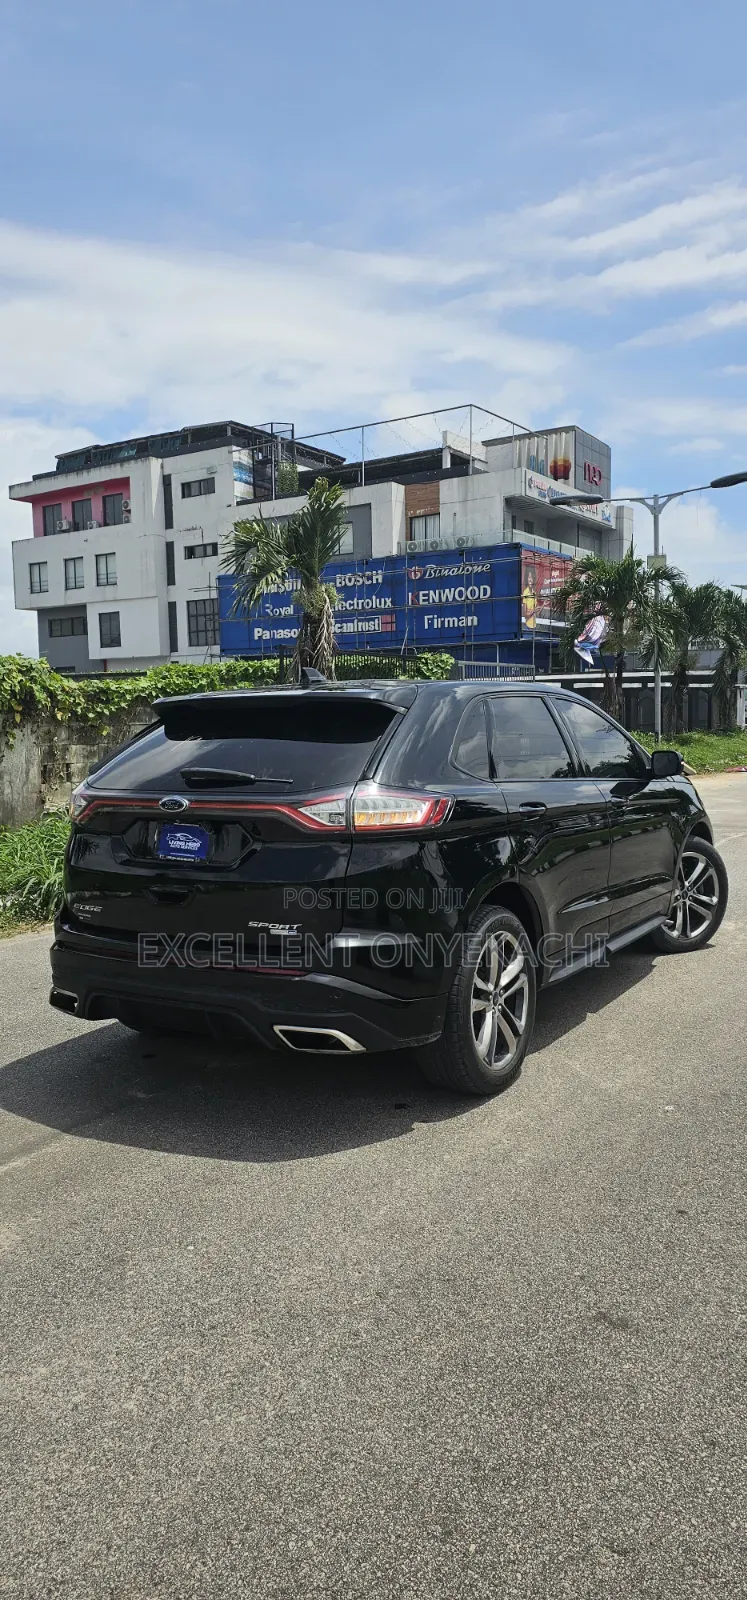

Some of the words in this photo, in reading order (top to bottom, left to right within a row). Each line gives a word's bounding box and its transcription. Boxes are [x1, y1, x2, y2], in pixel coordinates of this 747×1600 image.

[424, 563, 491, 579] Binatone
[336, 570, 383, 588] BOSCH
[408, 585, 491, 606] KENWOOD
[265, 604, 294, 617] Royal
[331, 595, 392, 612] lectrolux
[424, 615, 478, 630] Firman
[254, 627, 300, 640] Panaso
[73, 903, 103, 912] EDGE
[248, 921, 303, 930] SPORT
